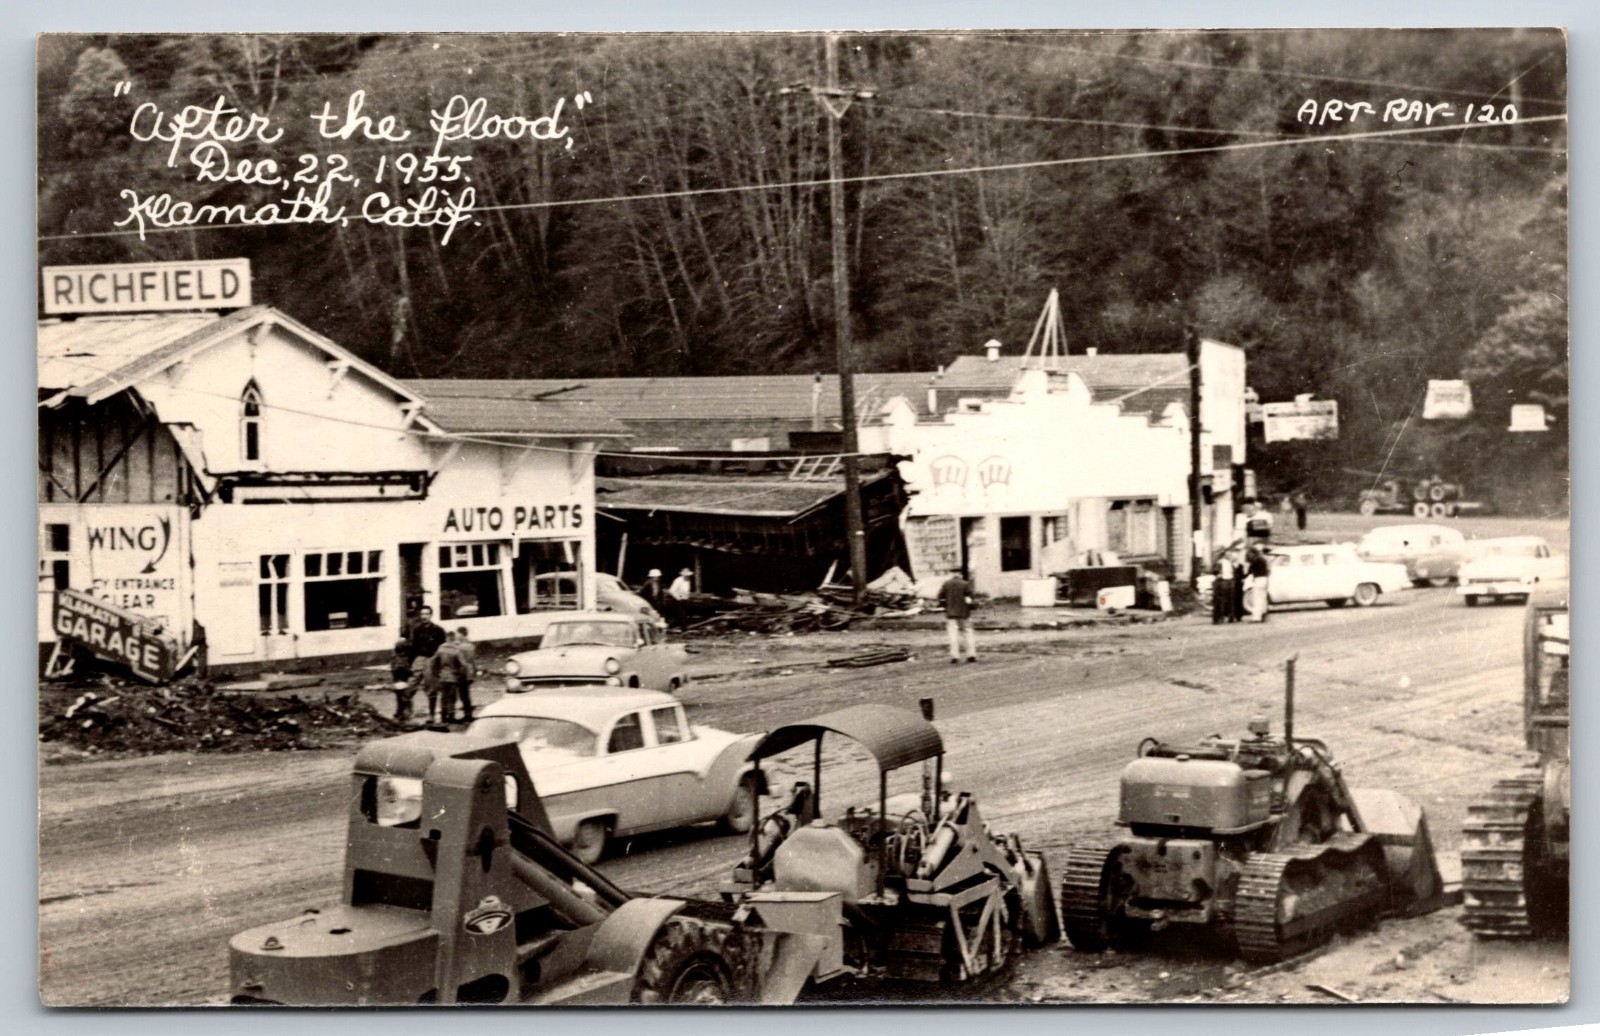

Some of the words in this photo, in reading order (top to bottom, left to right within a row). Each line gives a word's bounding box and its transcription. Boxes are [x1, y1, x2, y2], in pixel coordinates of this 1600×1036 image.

[54, 268, 240, 305] RICHFIELD
[443, 506, 503, 533] AUTO
[514, 504, 583, 530] PARTS
[115, 578, 175, 590] ENTRANCE
[57, 607, 160, 670] GARAGE
